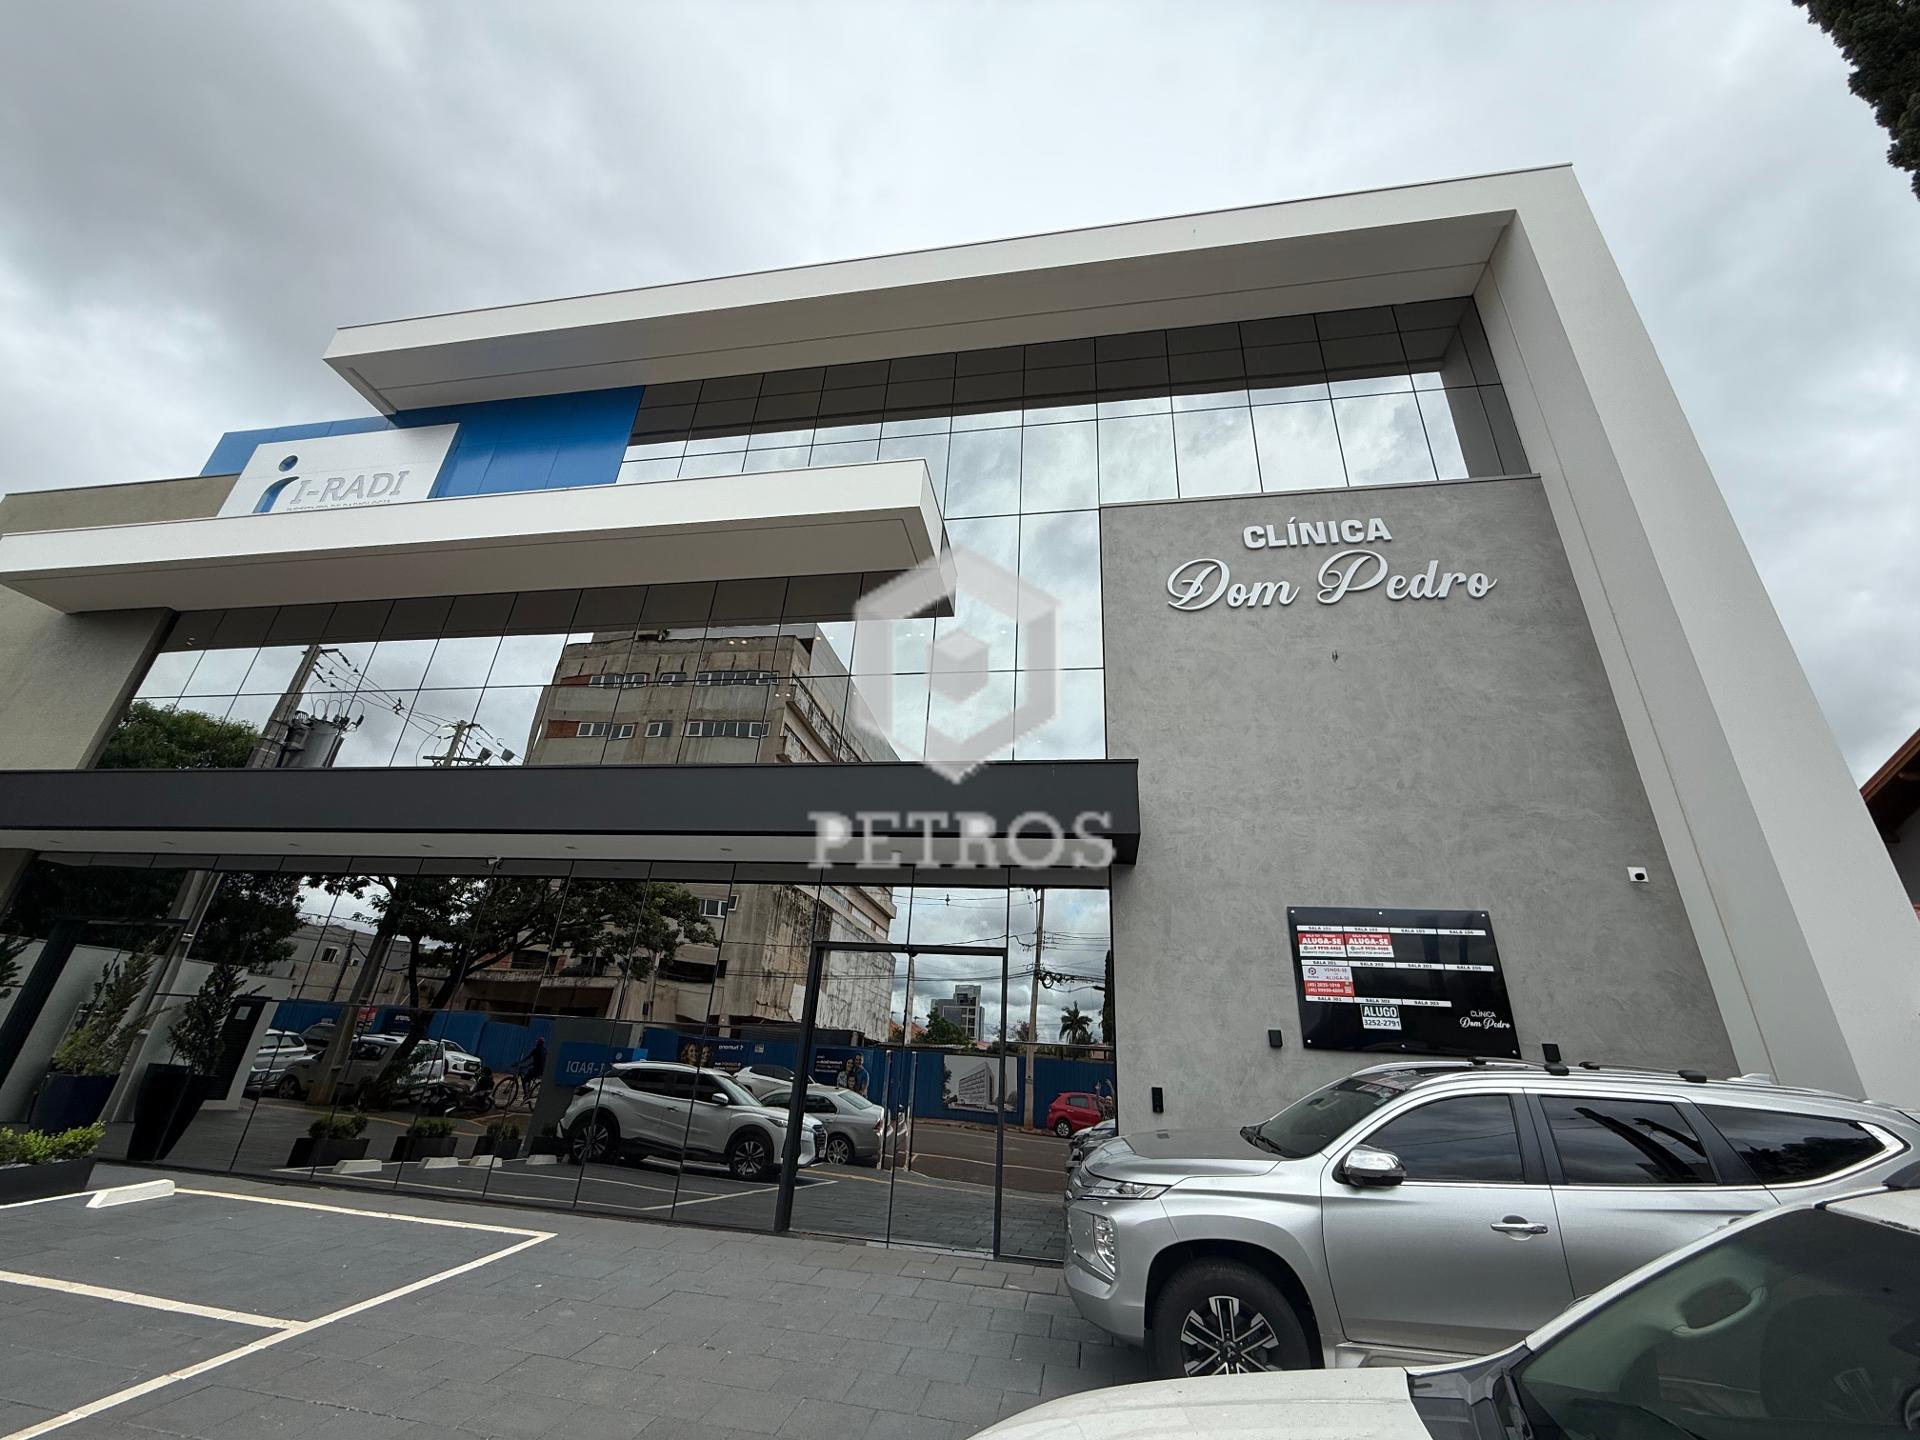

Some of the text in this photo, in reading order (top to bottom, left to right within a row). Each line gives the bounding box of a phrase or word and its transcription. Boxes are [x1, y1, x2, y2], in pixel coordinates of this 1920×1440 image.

[290, 470, 410, 505] I-RADI
[1243, 516, 1392, 549] CLÍNICA
[1167, 549, 1498, 611] Dom Pedro
[1364, 1006, 1398, 1018] ALUGO
[1483, 1017, 1511, 1030] Pedro
